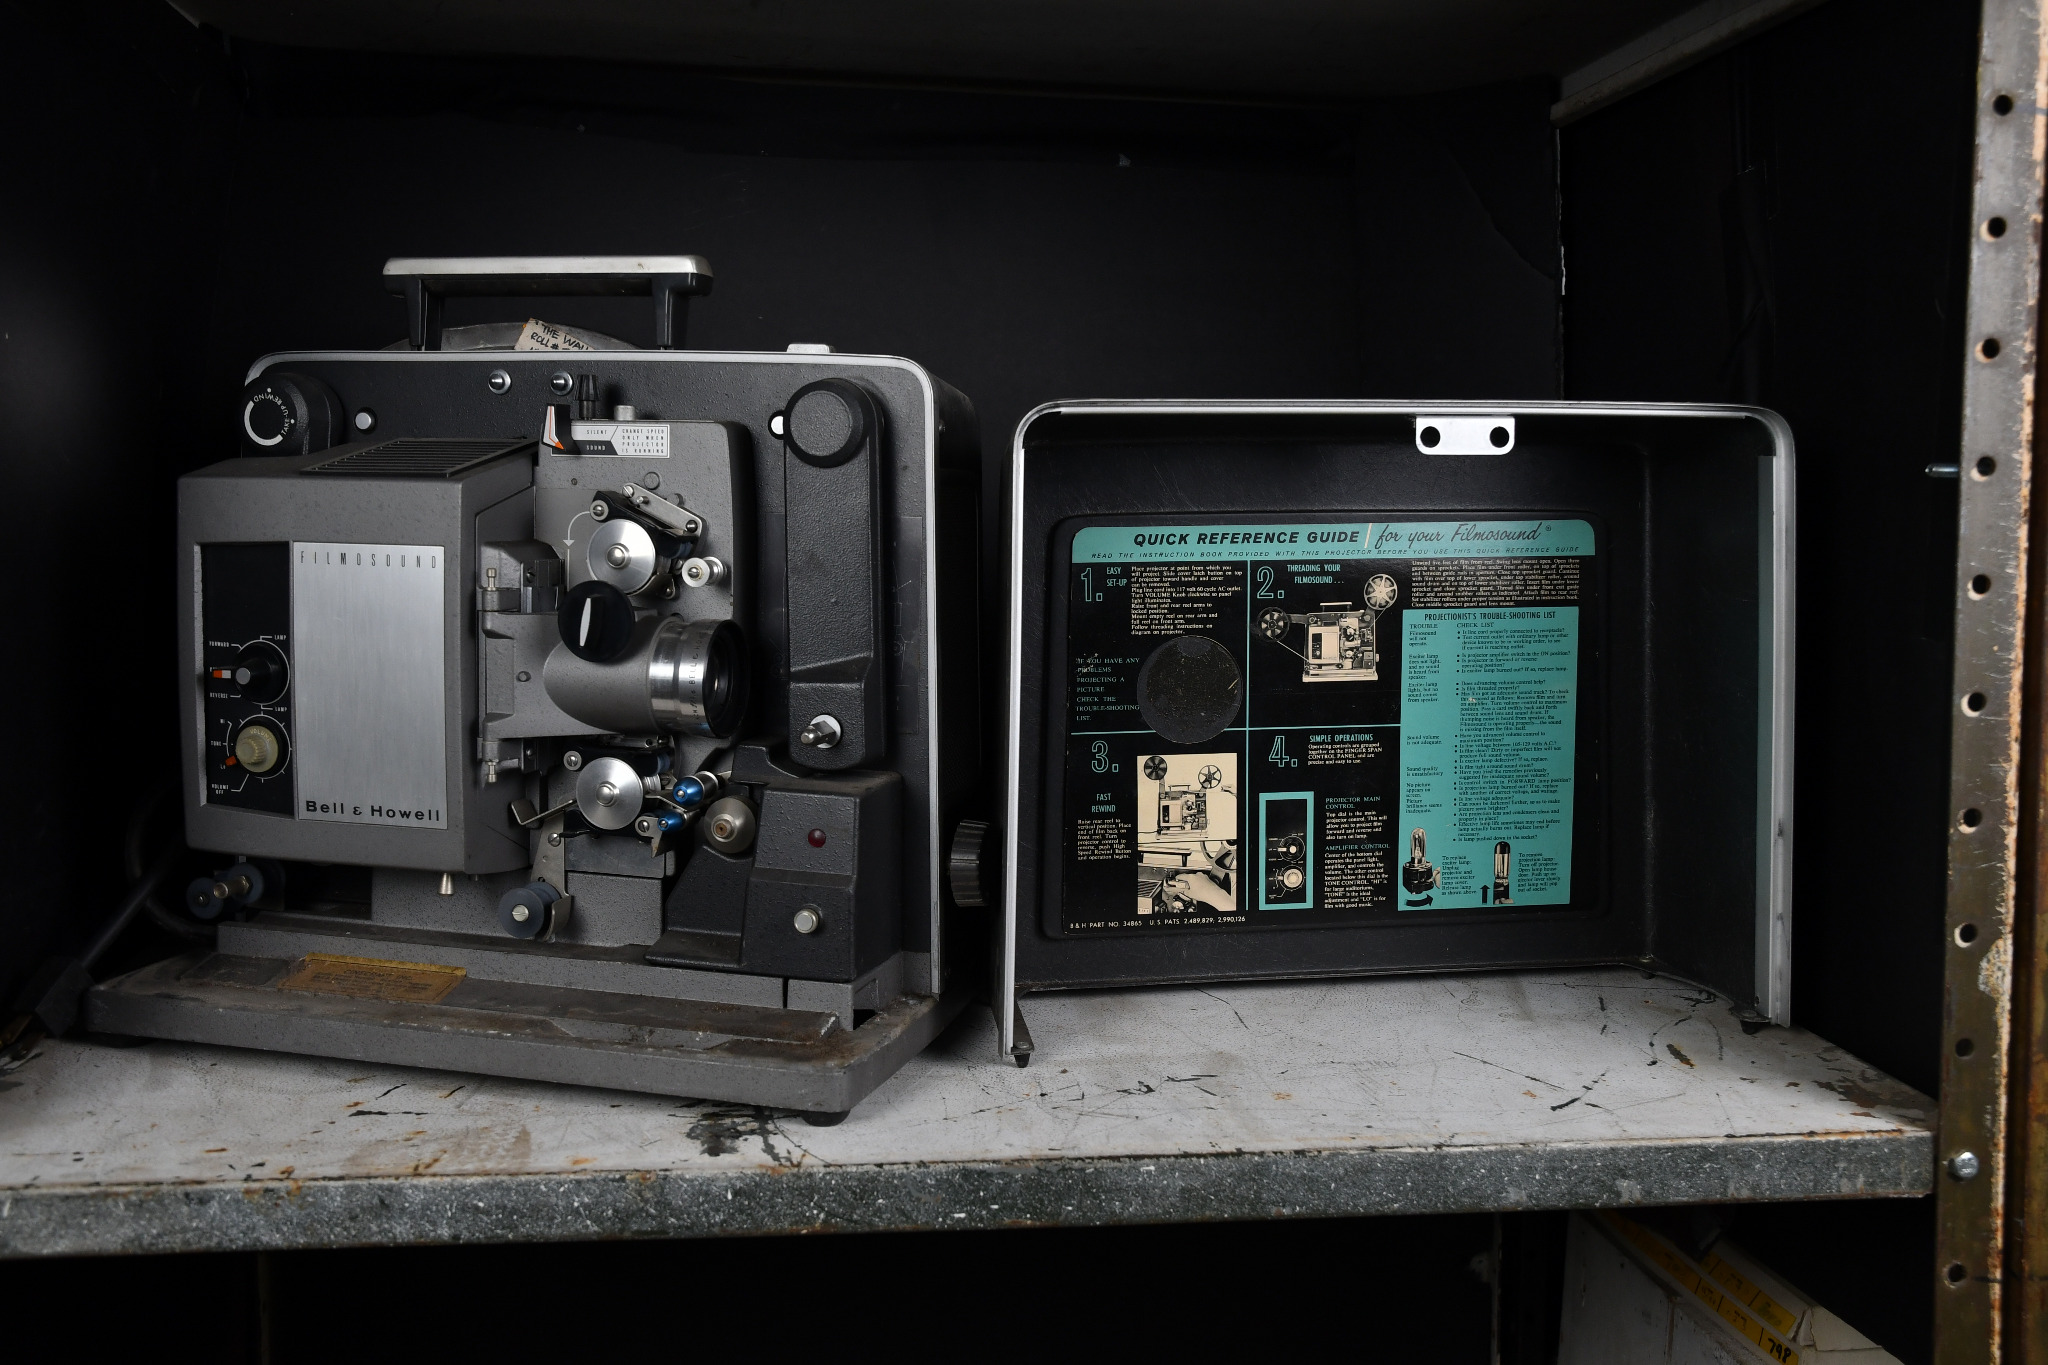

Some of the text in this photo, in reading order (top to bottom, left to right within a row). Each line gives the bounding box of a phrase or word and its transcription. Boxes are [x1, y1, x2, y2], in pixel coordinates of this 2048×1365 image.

[542, 324, 560, 339] THE
[531, 332, 550, 347] ROLL
[254, 393, 282, 405] REWIND
[1134, 533, 1191, 546] QUICK
[1197, 532, 1300, 545] REFERENCE
[1306, 531, 1360, 544] GUIDE
[1375, 524, 1402, 549] for
[1408, 530, 1445, 548] your
[300, 551, 436, 569] FILMOSOUND
[1106, 567, 1122, 575] EASY
[1287, 564, 1341, 572] THREADING YOUR
[1106, 579, 1127, 587] SET-UP
[1424, 611, 1556, 621] PROJECTIONIST'S TROUBLE-SHOOTING LIST
[1309, 734, 1373, 743] SIMPLE OPERATIONS
[1096, 792, 1112, 801] FAST
[306, 800, 344, 814] Bell
[370, 805, 440, 821] Howell
[1091, 805, 1116, 813] REWIND
